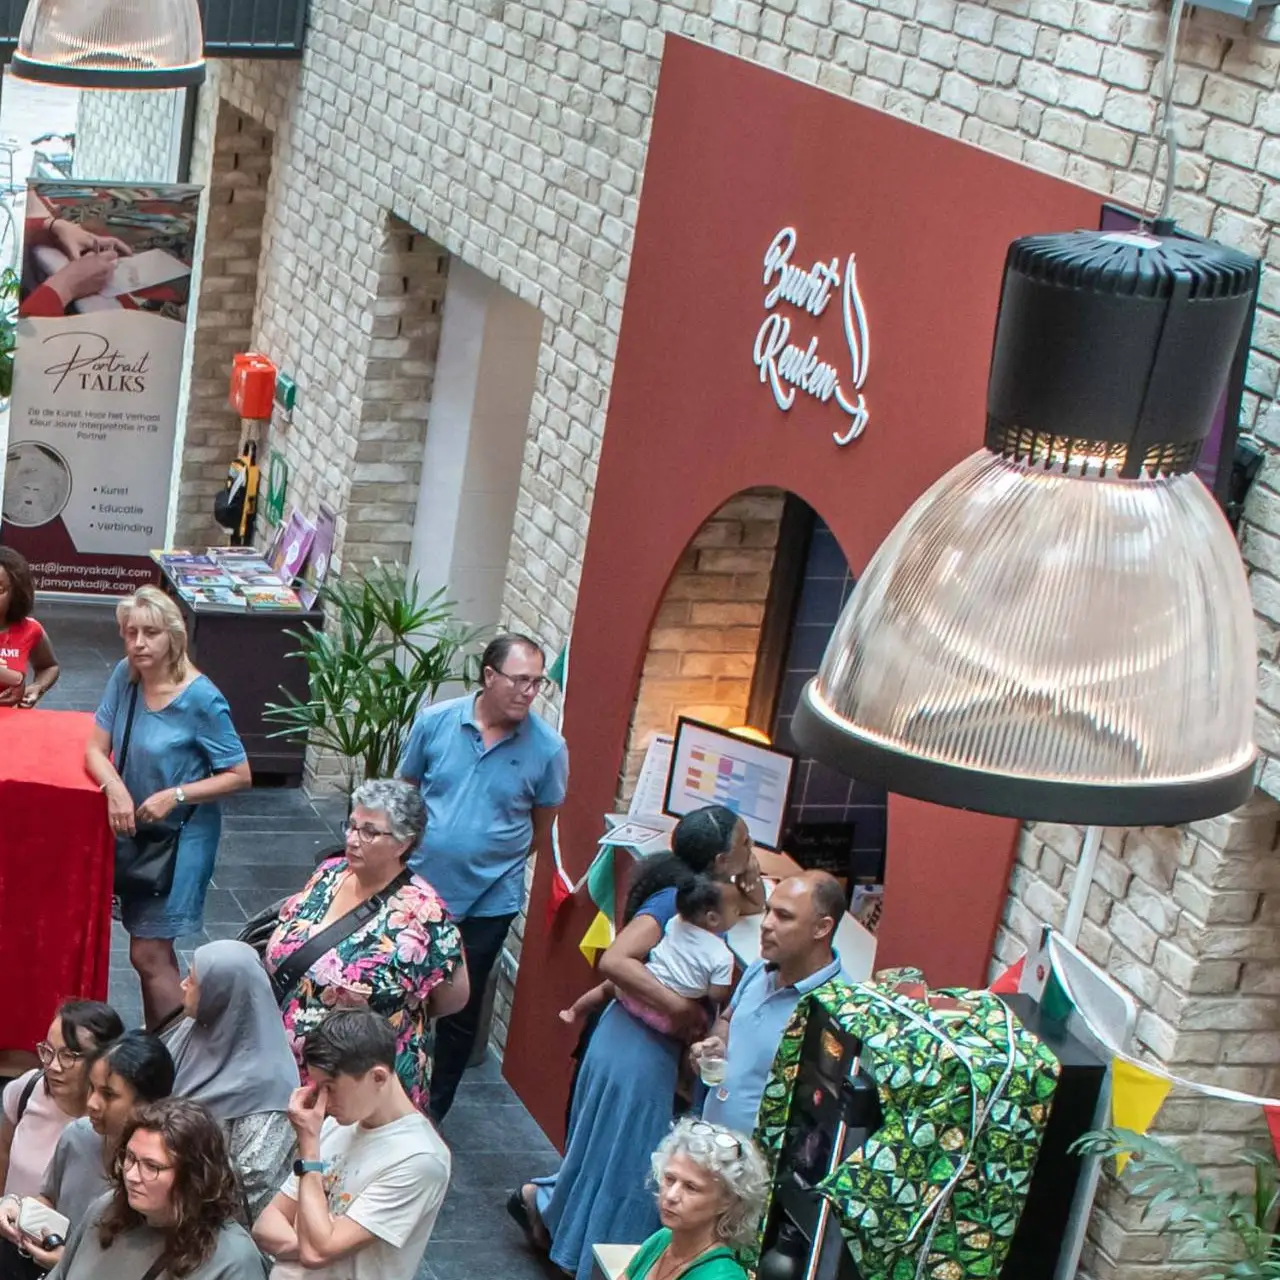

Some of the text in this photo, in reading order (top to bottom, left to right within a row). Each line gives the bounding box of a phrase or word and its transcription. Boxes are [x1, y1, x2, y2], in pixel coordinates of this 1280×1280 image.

[764, 226, 840, 316] Buurt
[42, 331, 150, 394] Portrait
[753, 313, 839, 411] Keuken
[78, 372, 145, 393] TALKS
[28, 407, 40, 416] Zie
[42, 408, 54, 416] de
[85, 411, 107, 419] Hoor
[108, 411, 123, 420] het
[125, 412, 161, 422] Verhaal
[29, 418, 51, 427] Kleur
[79, 421, 135, 432] Interpretatie
[77, 430, 107, 440] Portret
[100, 485, 129, 495] Kunst
[98, 504, 144, 515] Educatie
[97, 521, 154, 535] Verbinding
[28, 562, 152, 578] act@jamayakadijk.com
[34, 575, 136, 591] .jamayakadijk.com
